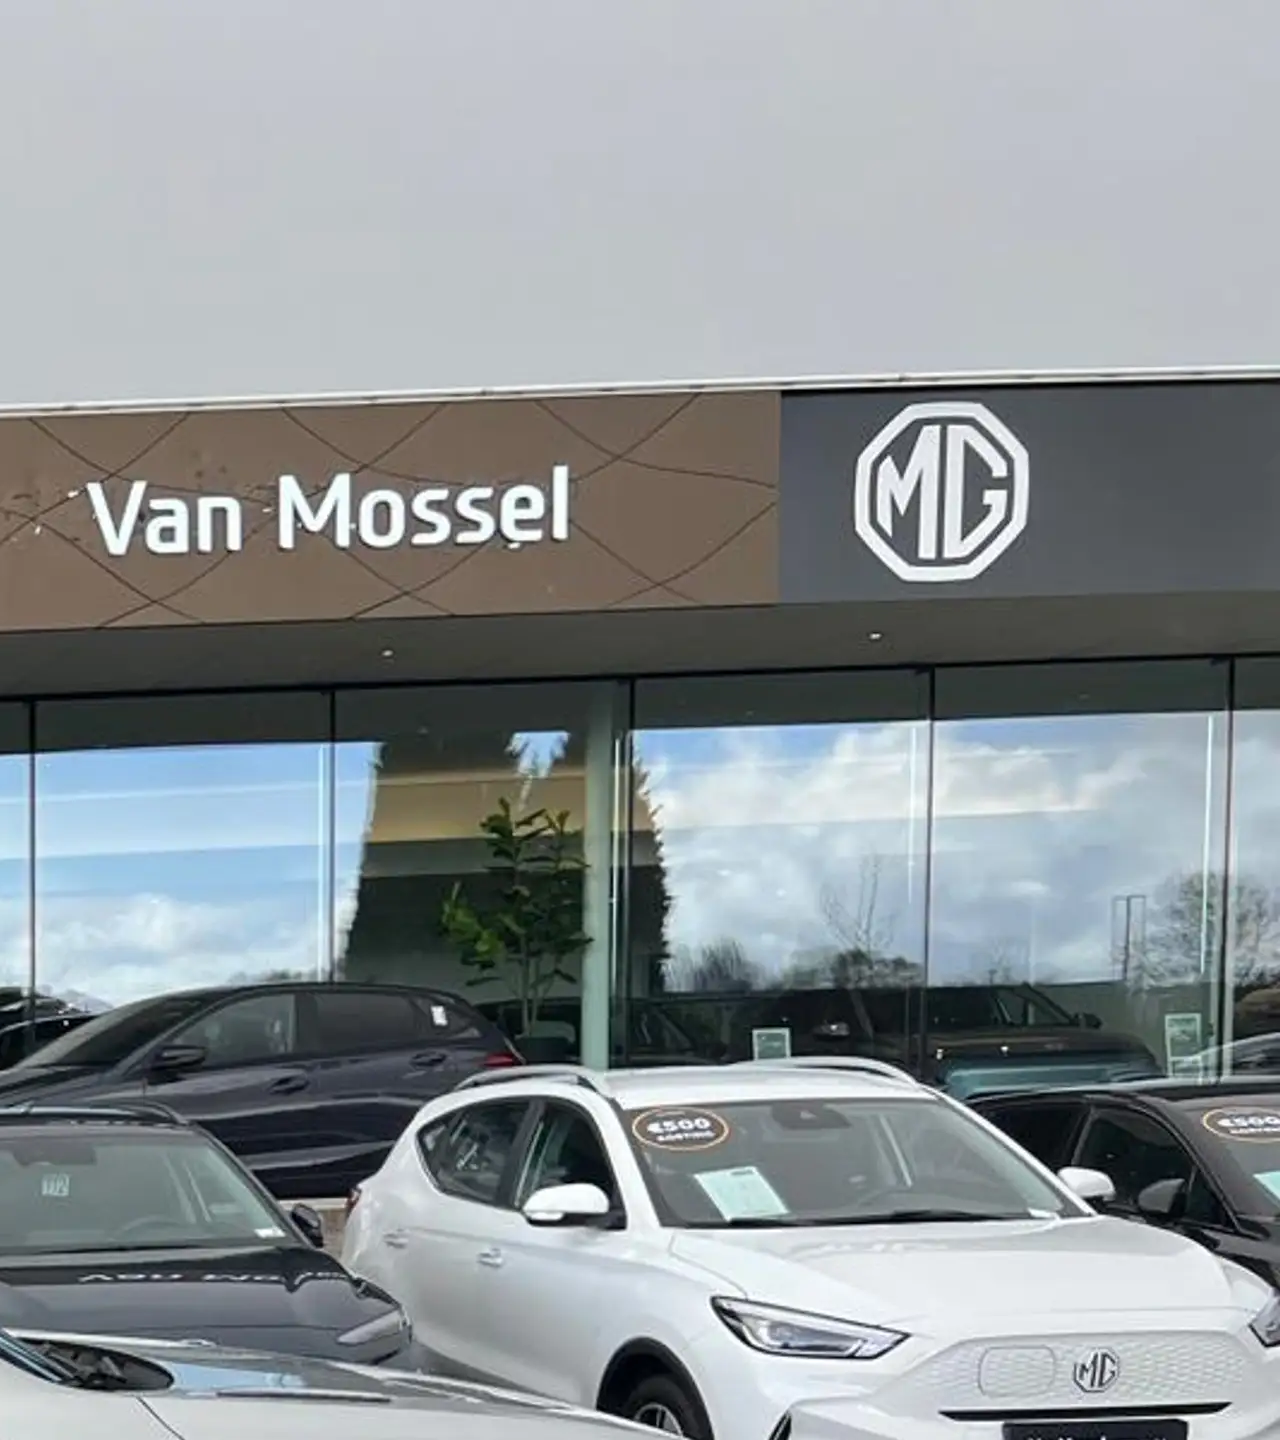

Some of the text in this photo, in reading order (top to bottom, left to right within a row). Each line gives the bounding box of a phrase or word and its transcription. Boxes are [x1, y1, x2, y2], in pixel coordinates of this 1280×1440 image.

[86, 464, 570, 556] Van Mossel
[872, 420, 1010, 562] MG
[646, 1117, 711, 1134] €500
[1077, 1351, 1118, 1390] MG
